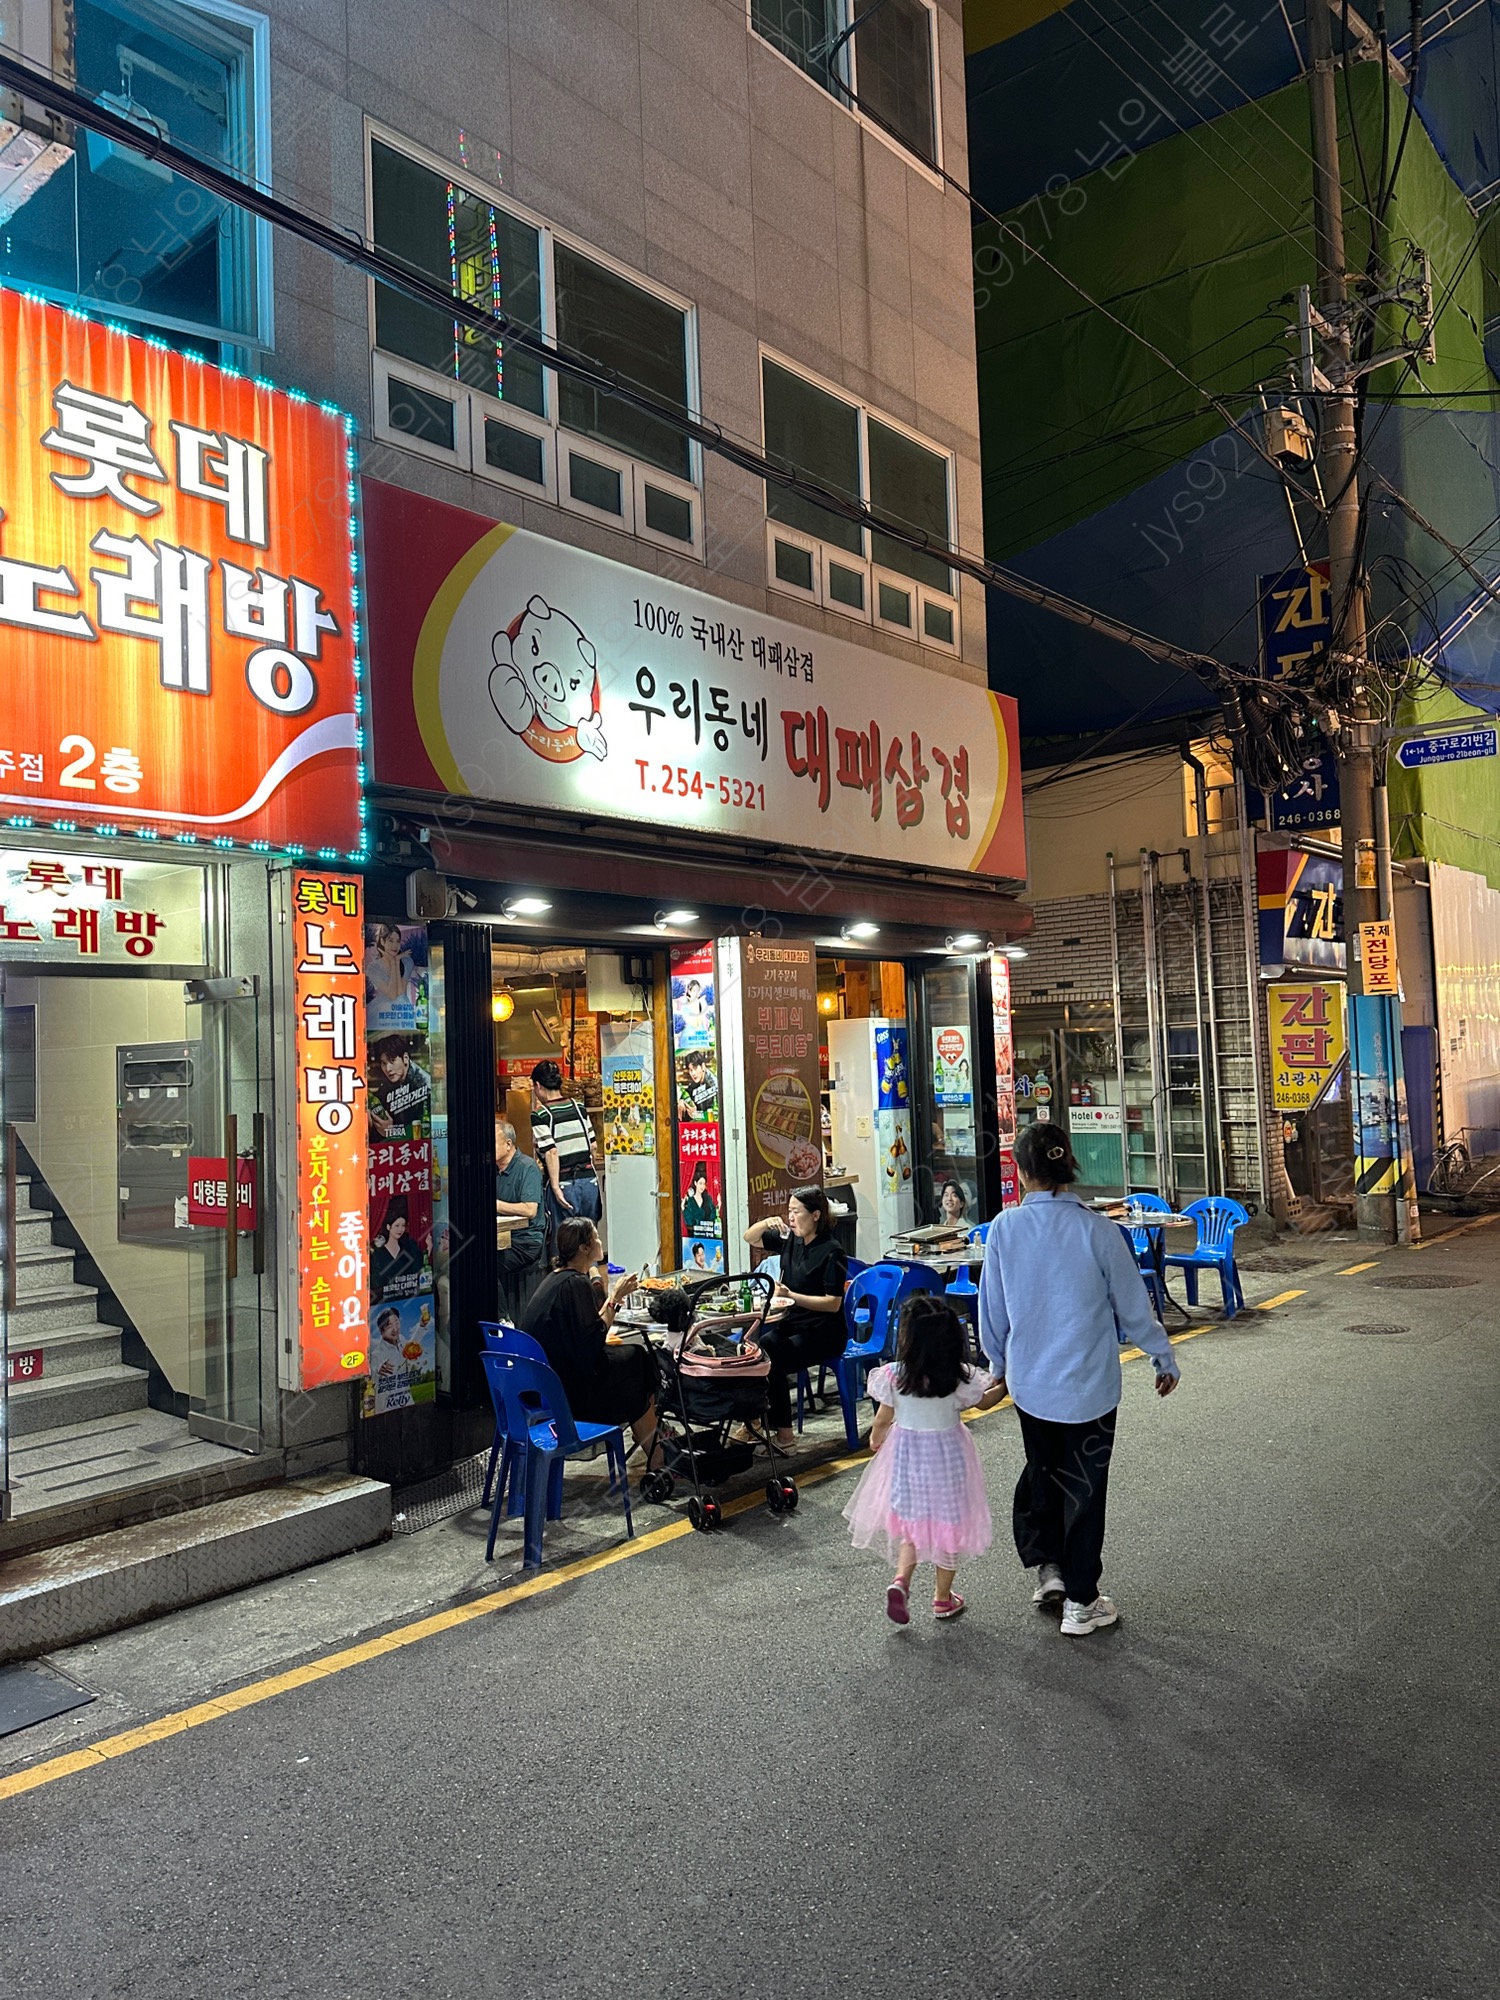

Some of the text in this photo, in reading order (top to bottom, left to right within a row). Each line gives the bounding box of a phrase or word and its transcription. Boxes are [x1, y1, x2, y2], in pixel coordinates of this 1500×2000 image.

[40, 380, 271, 550] 롯데
[633, 598, 815, 683] 100% 국내산 대패삼겹
[526, 728, 576, 753] 우리동네
[1428, 731, 1495, 754] 중구로21번길
[58, 734, 144, 794] 2층
[628, 666, 972, 841] 우리동네 대패삼겹
[1419, 746, 1494, 764] Junggu-ro 21beon-gil
[634, 758, 766, 813] T.254-5321
[1278, 809, 1341, 826] 246-0368
[22, 858, 124, 902] 롯데
[297, 878, 358, 917] 롯데
[1363, 924, 1390, 938] 국제
[755, 948, 783, 962] 우리동네
[1366, 938, 1391, 986] 전당포
[763, 968, 777, 982] 고기
[746, 985, 773, 1000] 15가지
[297, 922, 365, 1135] 노래방
[758, 1006, 803, 1031] 뷔페식
[1276, 1071, 1322, 1087] 신광사
[1276, 1092, 1311, 1104] 246-0368
[1071, 1111, 1093, 1120] Hotel
[384, 1127, 407, 1138] TERRA
[749, 1169, 777, 1195] 100%
[193, 1180, 252, 1209] 대형룸비
[762, 1189, 788, 1207] 국내산
[337, 1210, 367, 1331] 좋아요
[346, 1354, 359, 1366] 2F
[386, 1394, 411, 1409] Kelly
